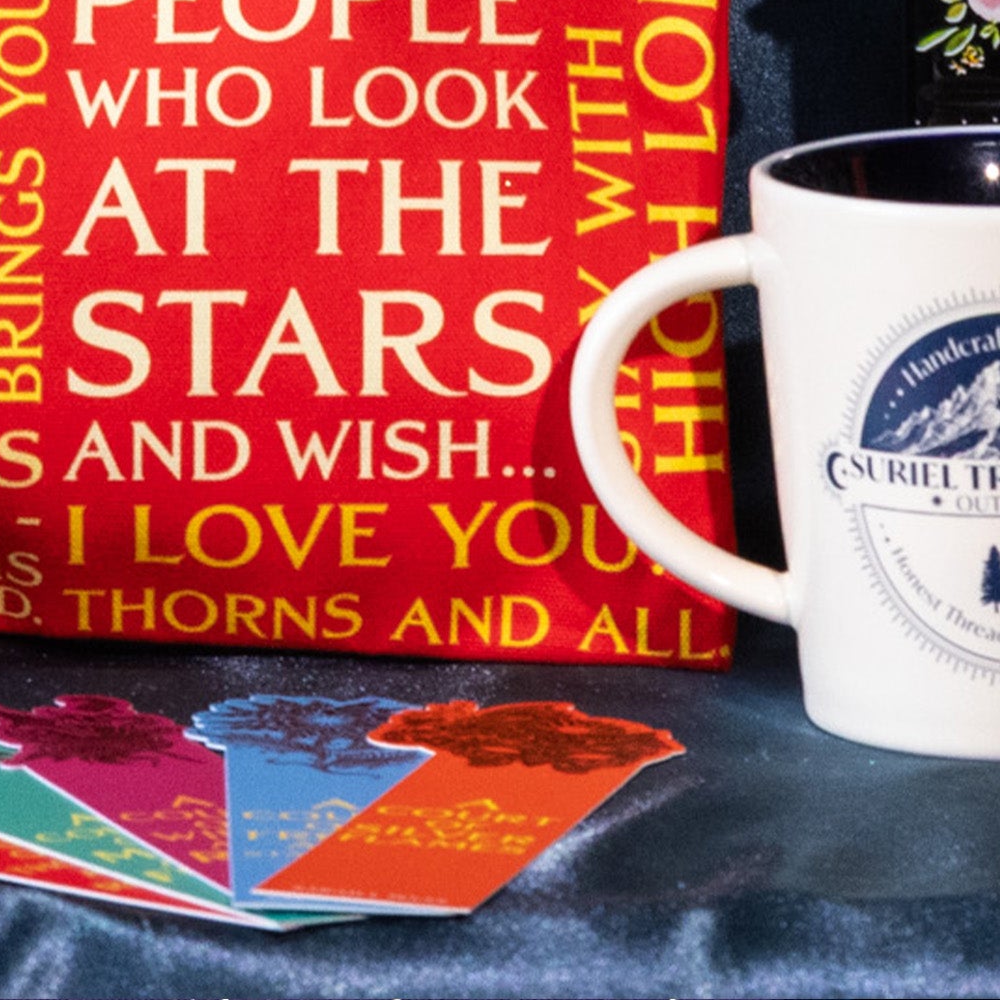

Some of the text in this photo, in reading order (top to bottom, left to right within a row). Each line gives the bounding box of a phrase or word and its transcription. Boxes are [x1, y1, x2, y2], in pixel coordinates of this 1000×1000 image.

[66, 65, 549, 130] WHO LOOK
[565, 24, 637, 236] WITH
[62, 156, 552, 256] AT THE
[66, 287, 554, 399] STARS
[62, 420, 557, 482] AND WISH...
[850, 455, 959, 490] SURIEL
[67, 503, 88, 567] I
[133, 502, 393, 570] LOVE
[892, 547, 943, 611] Honest
[62, 587, 732, 661] THORNS AND ALL.
